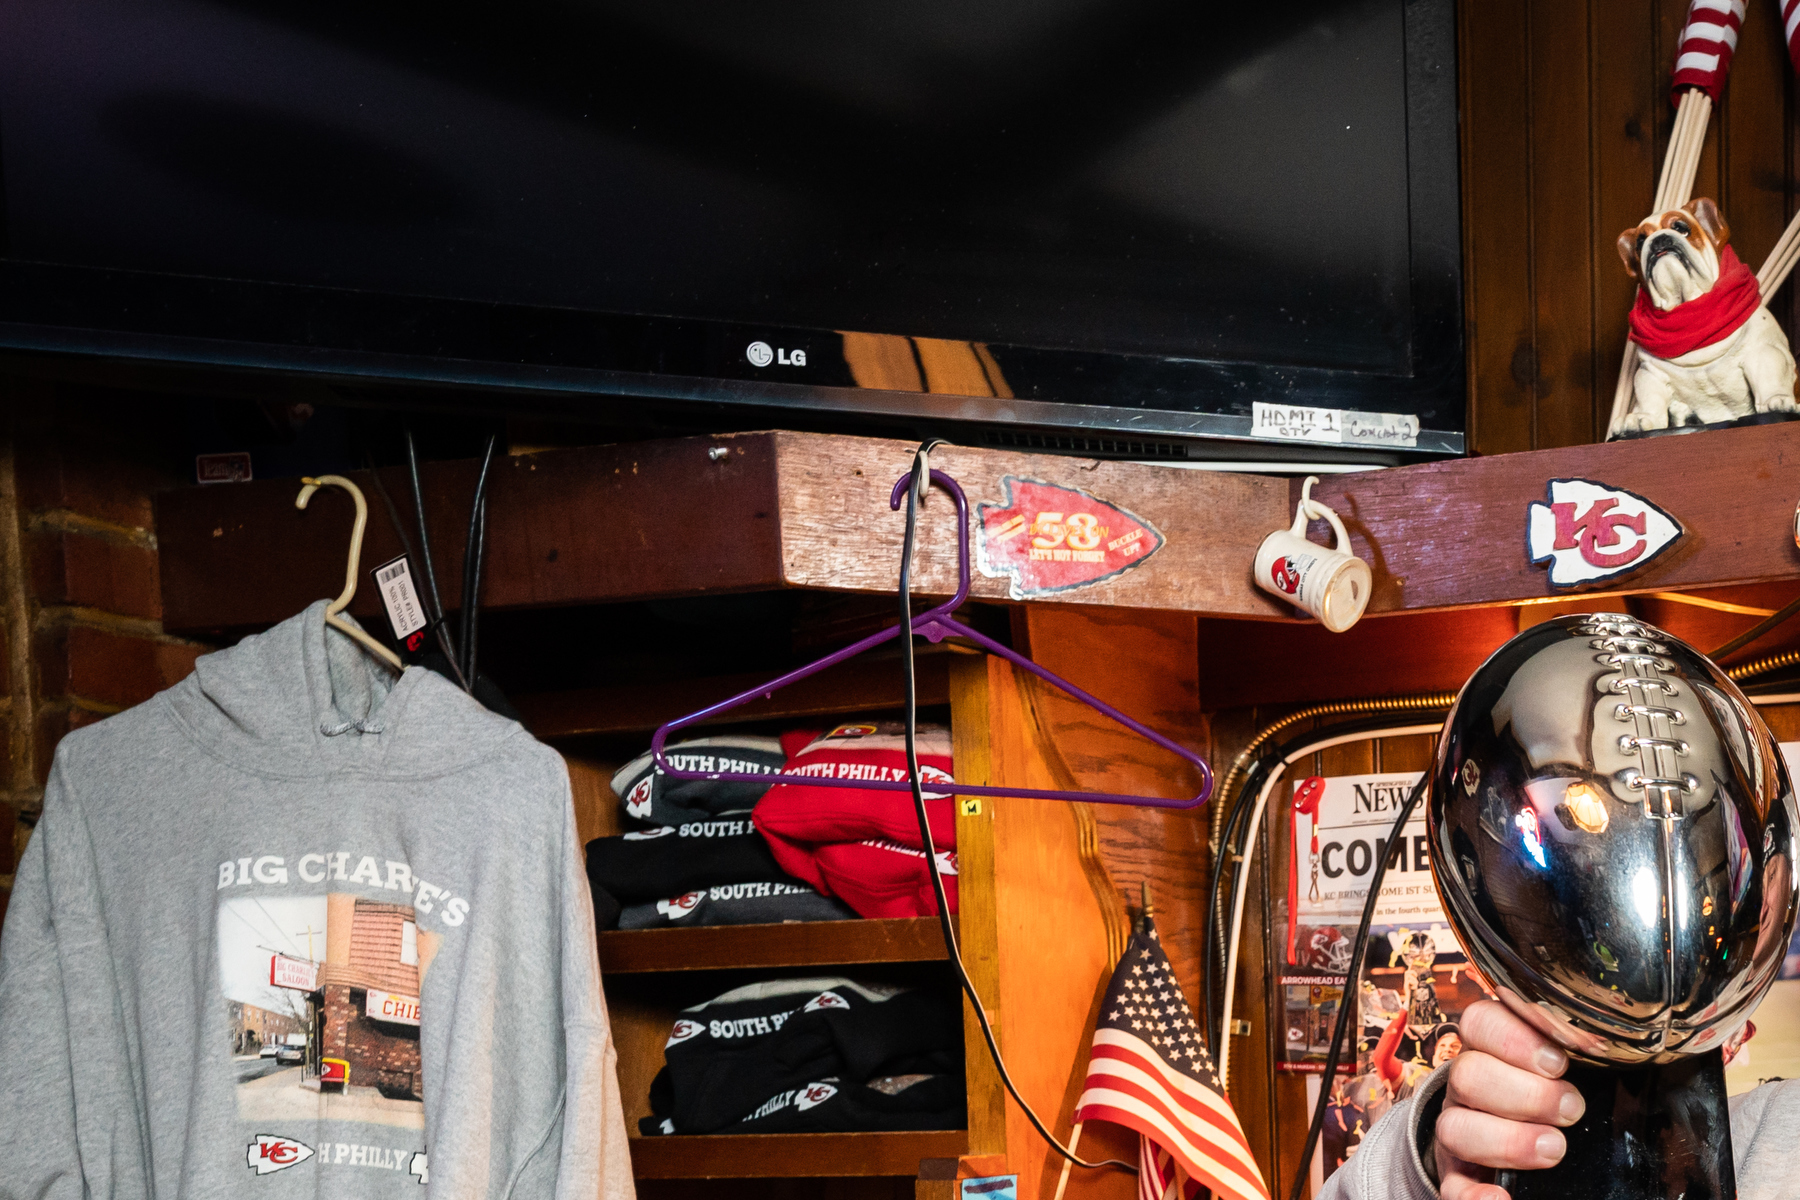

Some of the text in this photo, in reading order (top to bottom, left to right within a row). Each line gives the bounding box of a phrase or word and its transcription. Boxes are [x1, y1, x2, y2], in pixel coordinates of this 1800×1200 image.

[777, 349, 806, 367] LG
[1262, 409, 1316, 427] HDMI
[1108, 527, 1144, 552] BUCKLE
[679, 820, 744, 838] SOUTH
[217, 855, 289, 890] BIG
[710, 882, 771, 901] SOUTH
[1324, 892, 1336, 900] KC
[1385, 907, 1397, 915] the
[1399, 906, 1421, 915] fourth
[282, 972, 310, 986] SALOON
[1281, 976, 1333, 985] ARROWHEAD
[382, 999, 421, 1021] CHIE
[709, 1016, 771, 1040] SOUTH
[333, 1142, 409, 1171] PHILLY
